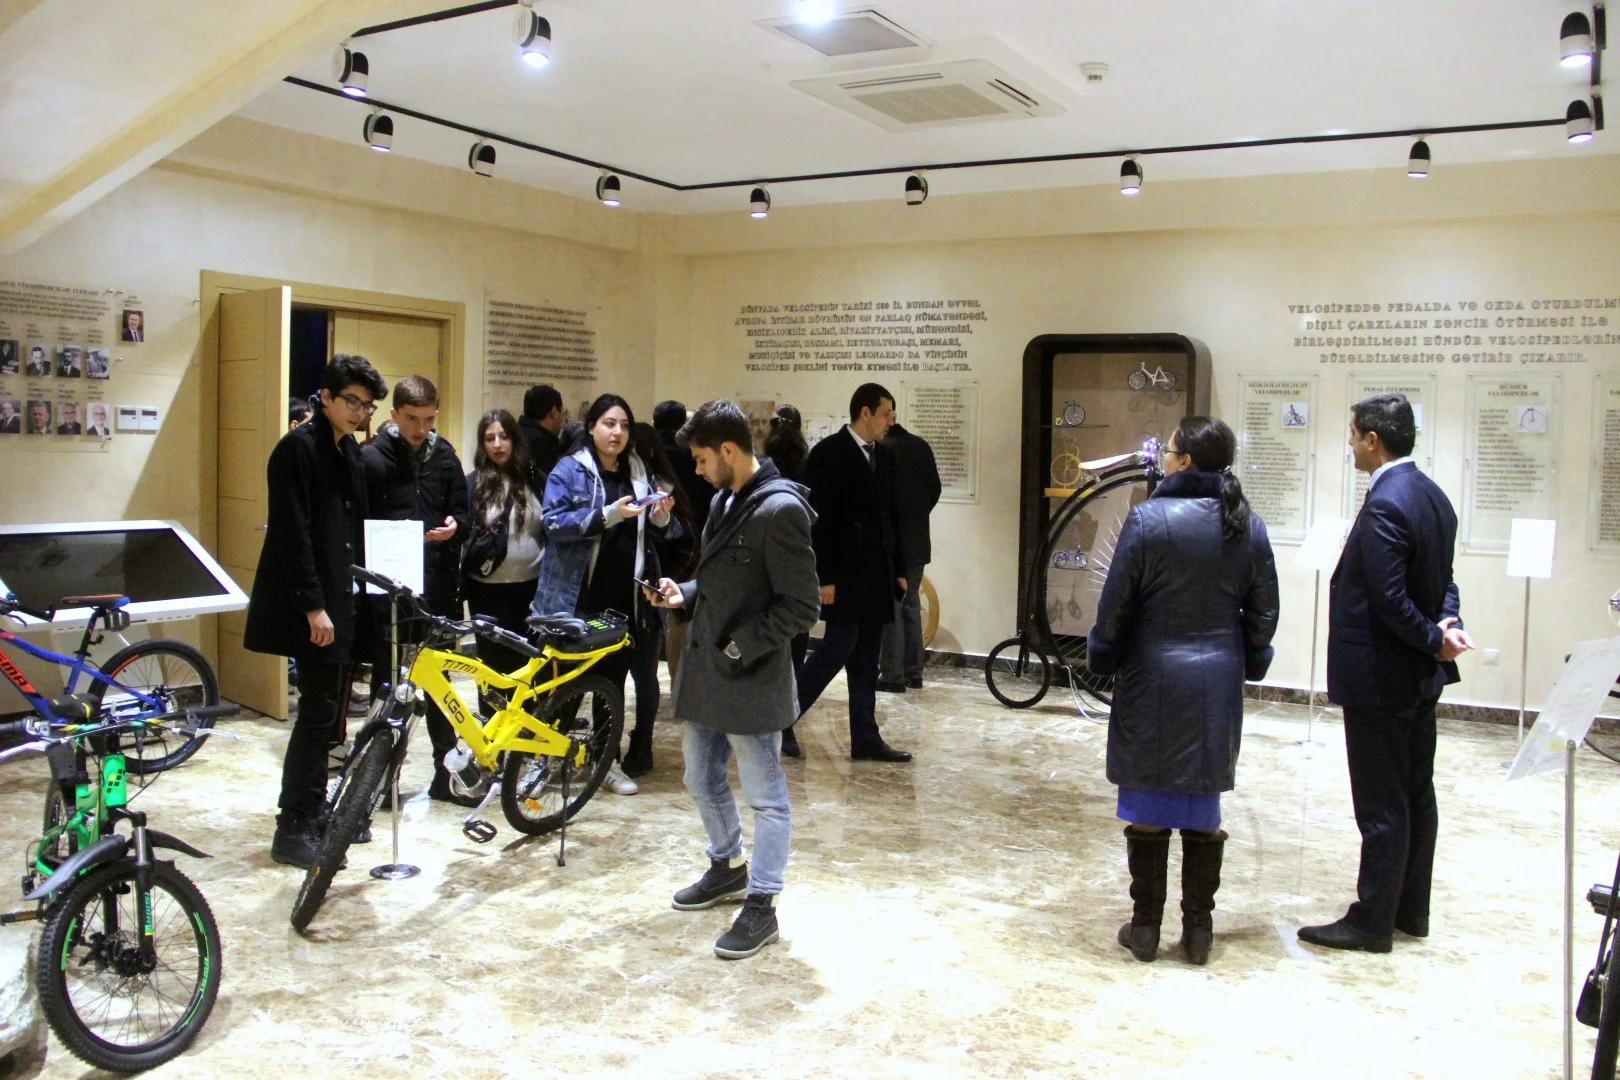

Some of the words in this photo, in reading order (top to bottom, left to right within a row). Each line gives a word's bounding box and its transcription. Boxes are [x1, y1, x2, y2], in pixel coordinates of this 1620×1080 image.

[741, 304, 780, 313] DÜNYADA
[783, 303, 839, 313] VELOSİPEDİN
[842, 301, 873, 311] TARİXİ
[893, 301, 903, 310] İL
[906, 301, 944, 310] BUNDAN
[947, 300, 981, 309] ƏVVƏL
[1287, 302, 1382, 314] VELOSİPEDDƏ
[1387, 301, 1452, 313] PEDALDA
[1458, 300, 1478, 311] VƏ
[1484, 300, 1525, 311] OXDA
[735, 316, 768, 326] AVROPA
[875, 314, 912, 323] PARLAQ
[1305, 319, 1342, 332] DİŞLİ
[1347, 319, 1428, 332] ÇARXLARIN
[1433, 317, 1489, 329] ZƏNCİR
[1495, 315, 1575, 329] ÖTÜRMƏSİ
[1580, 315, 1609, 328] İLƏ
[1293, 335, 1417, 349] BİRLƏŞDİRİLMƏSİ
[1423, 334, 1483, 347] HÜNDÜR
[799, 351, 811, 360] VƏ
[855, 350, 905, 359] LEONARDO
[908, 350, 920, 359] DA
[1319, 352, 1446, 364] DÜZƏLDİLMƏSİNƏ
[1451, 351, 1514, 363] GƏTİRİB
[1518, 352, 1589, 365] ÇIXARIR.
[745, 363, 791, 372] VELOSİPED
[831, 362, 864, 372] TƏSVİR
[866, 362, 901, 372] ETMƏSİ
[902, 361, 920, 372] İLƏ
[922, 362, 973, 373] BAŞLAYIR.
[442, 658, 478, 674] TITAN
